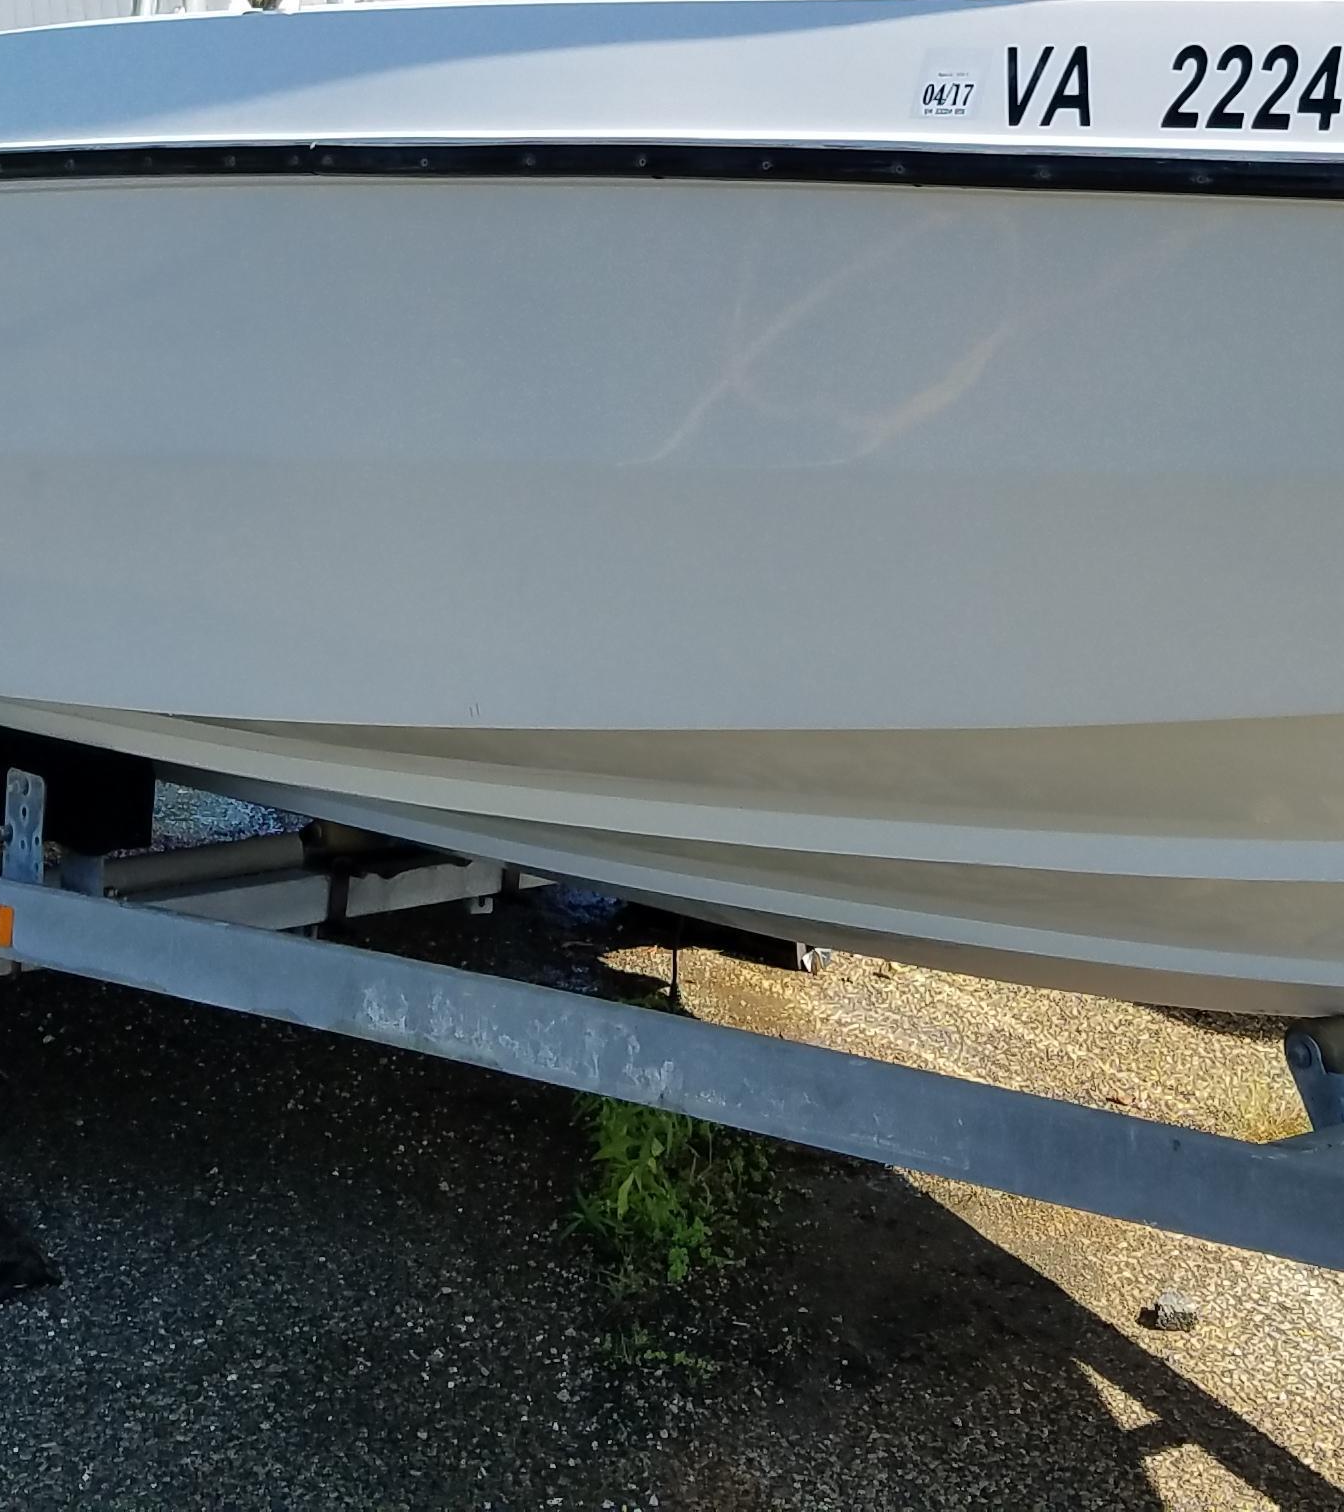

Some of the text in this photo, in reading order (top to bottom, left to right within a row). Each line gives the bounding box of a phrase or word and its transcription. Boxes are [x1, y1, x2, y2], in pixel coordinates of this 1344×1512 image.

[922, 82, 975, 107] 04/17
[1007, 45, 1092, 127] VA
[1160, 44, 1343, 131] 2224
